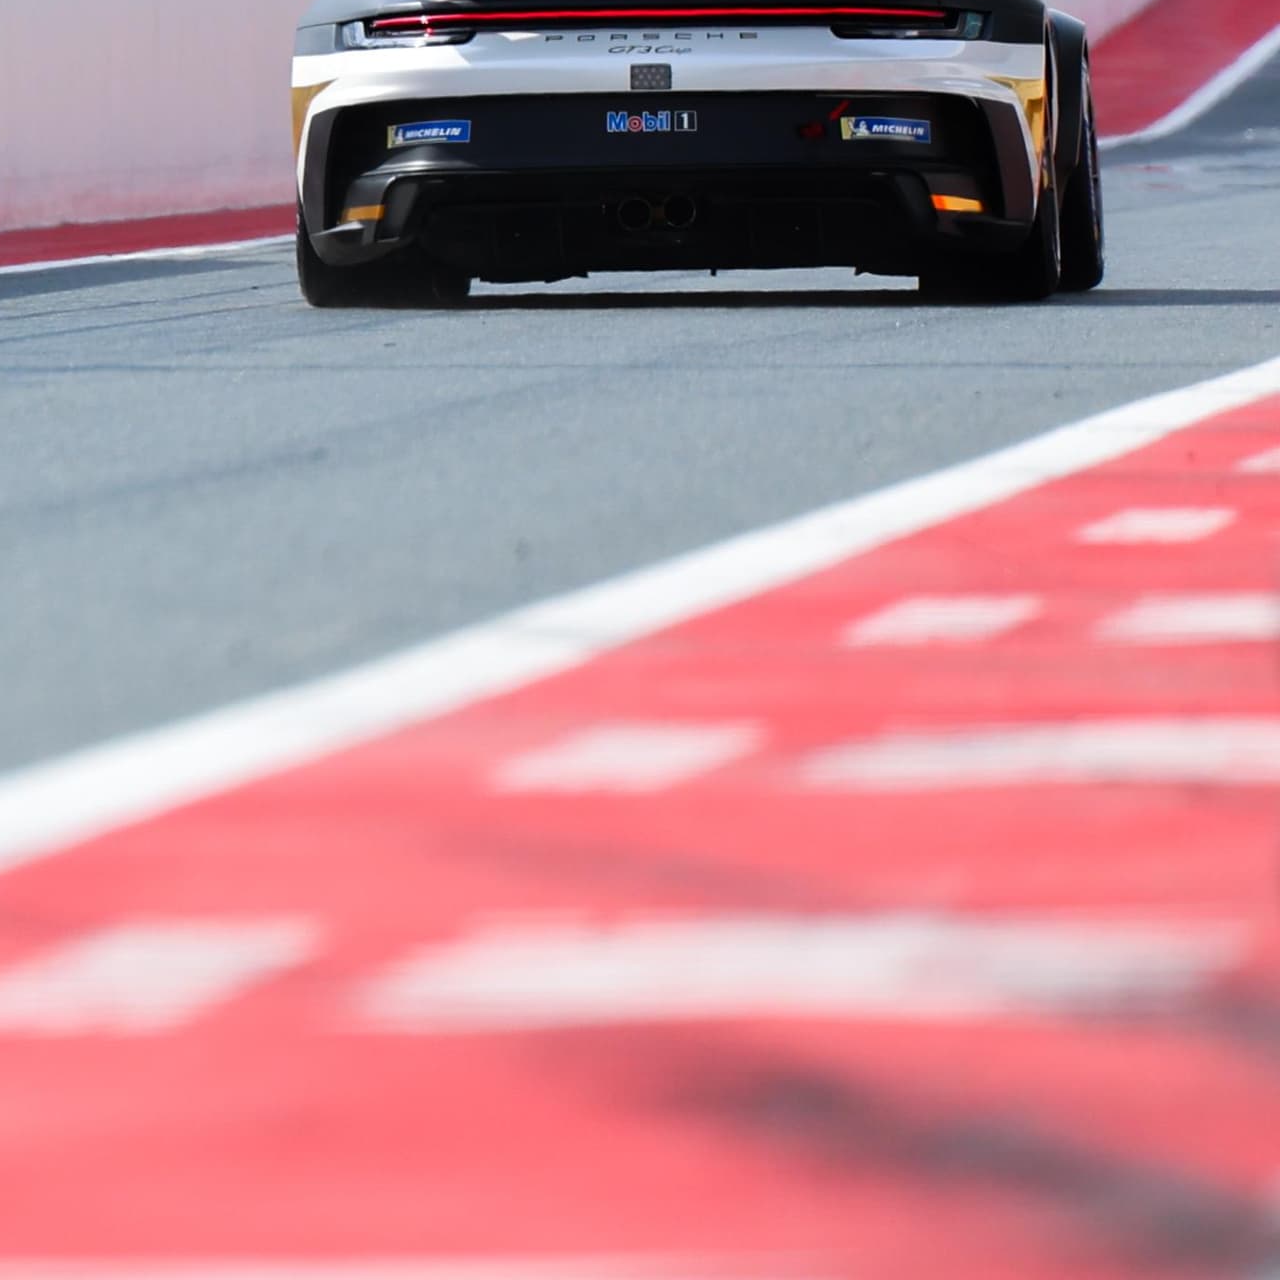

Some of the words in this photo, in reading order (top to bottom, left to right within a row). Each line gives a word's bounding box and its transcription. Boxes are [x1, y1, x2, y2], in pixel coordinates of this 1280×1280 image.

[545, 32, 758, 42] PORSCHE
[608, 45, 653, 55] GT3
[655, 45, 692, 56] Cup
[607, 110, 671, 132] Mobil
[404, 127, 462, 139] MICHELIN
[871, 123, 925, 136] MICHELIN
